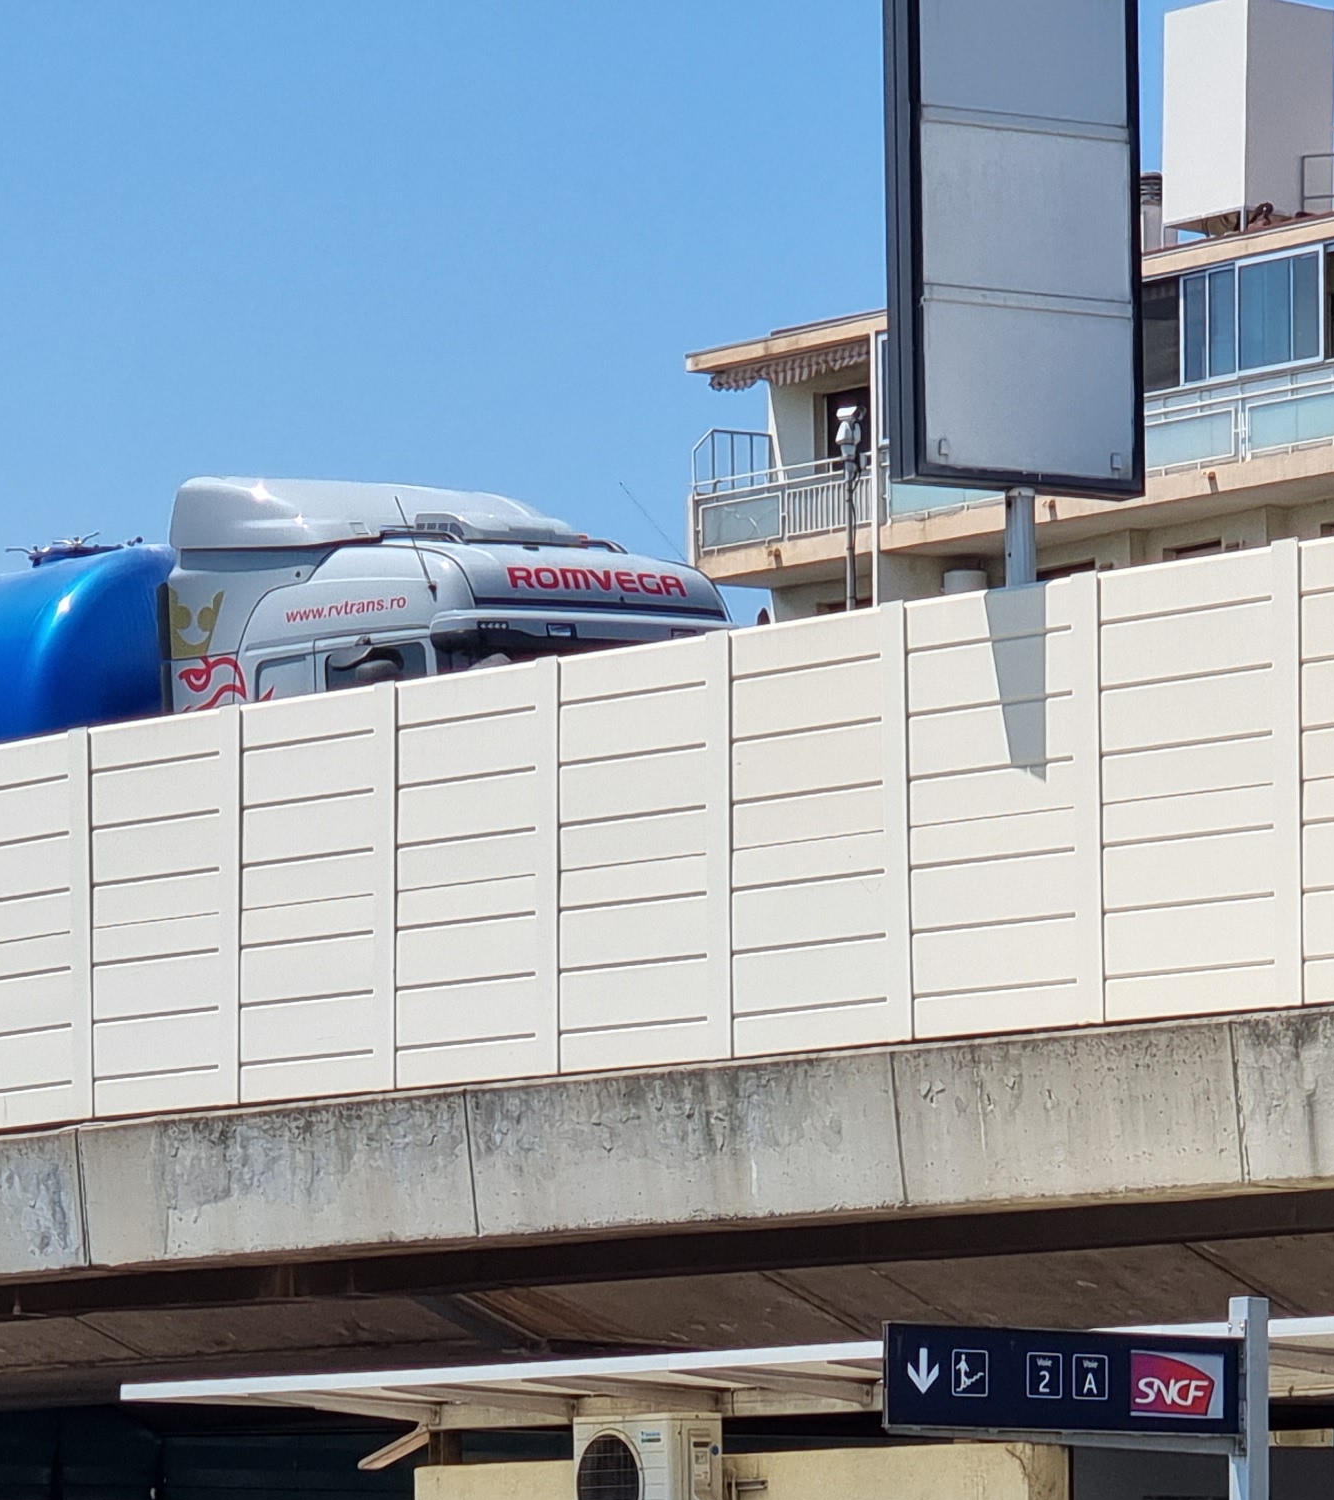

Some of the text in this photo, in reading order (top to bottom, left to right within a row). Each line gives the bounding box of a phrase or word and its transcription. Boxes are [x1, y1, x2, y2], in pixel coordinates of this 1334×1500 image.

[507, 567, 688, 598] ROMVEGA
[285, 596, 407, 623] www.rvtrans.ro
[1039, 1371, 1098, 1395] 2 A
[1134, 1377, 1210, 1406] SNCF
